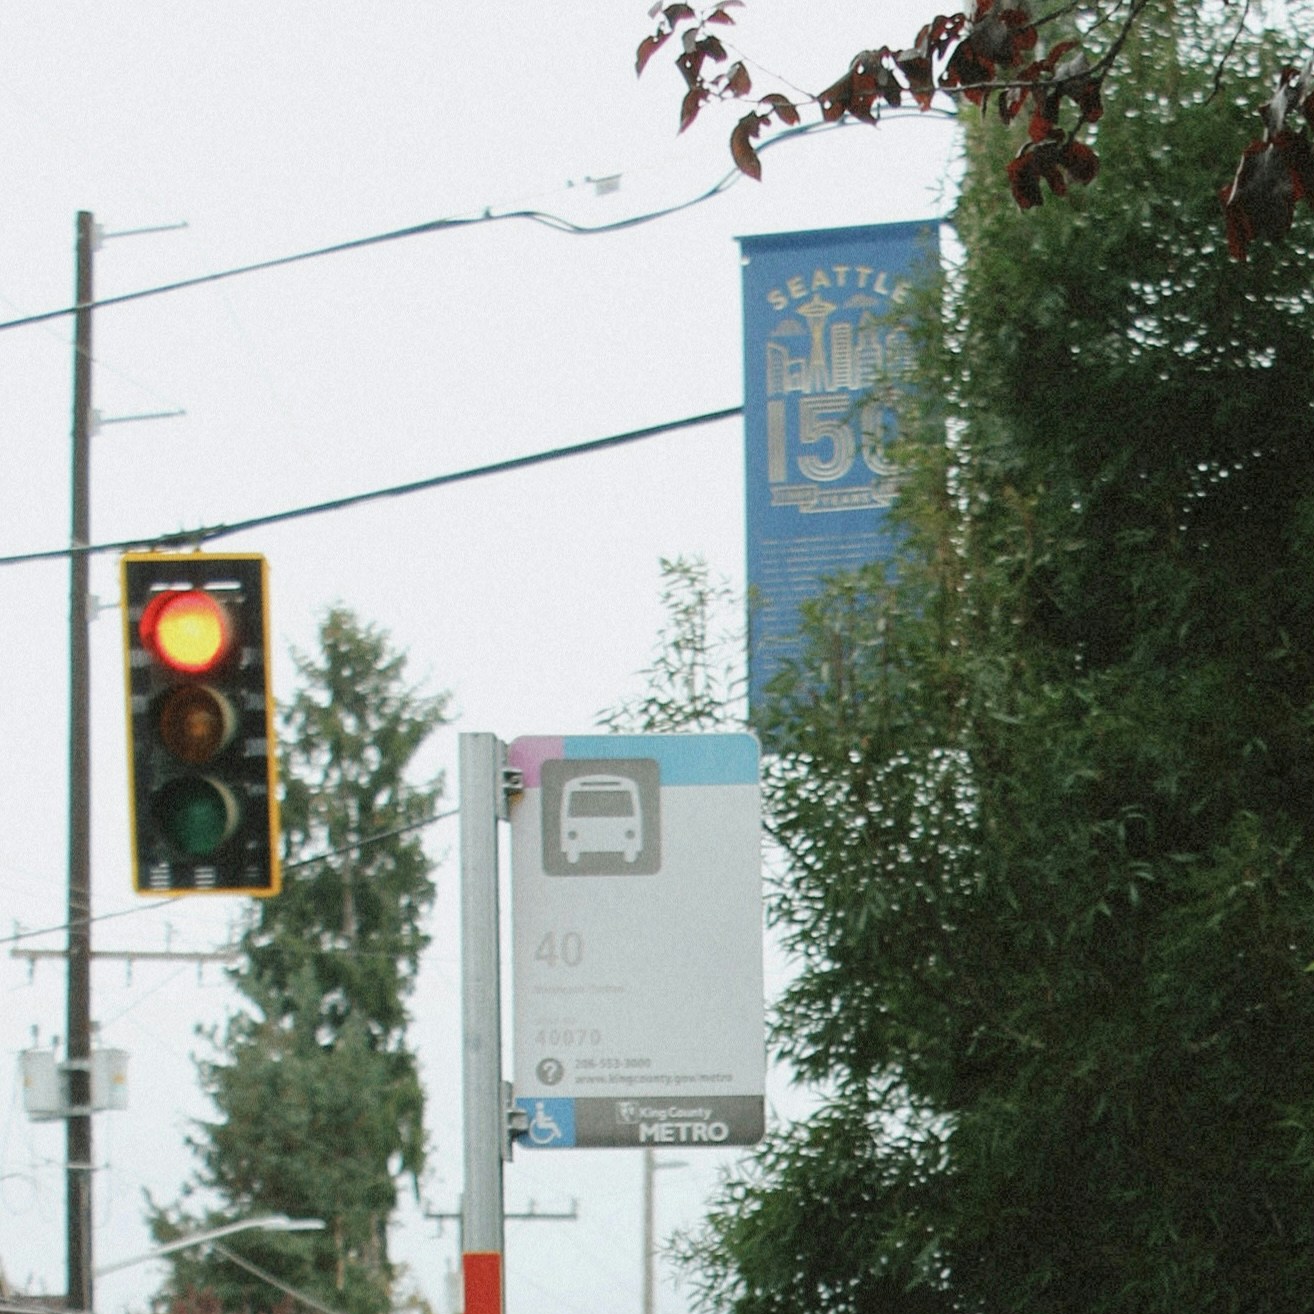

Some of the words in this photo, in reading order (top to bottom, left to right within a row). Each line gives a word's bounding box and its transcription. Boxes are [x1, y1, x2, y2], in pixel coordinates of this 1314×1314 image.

[766, 265, 912, 310] SEATTLE
[534, 930, 583, 967] 40
[667, 1106, 712, 1120] County
[639, 1121, 729, 1142] METRO
